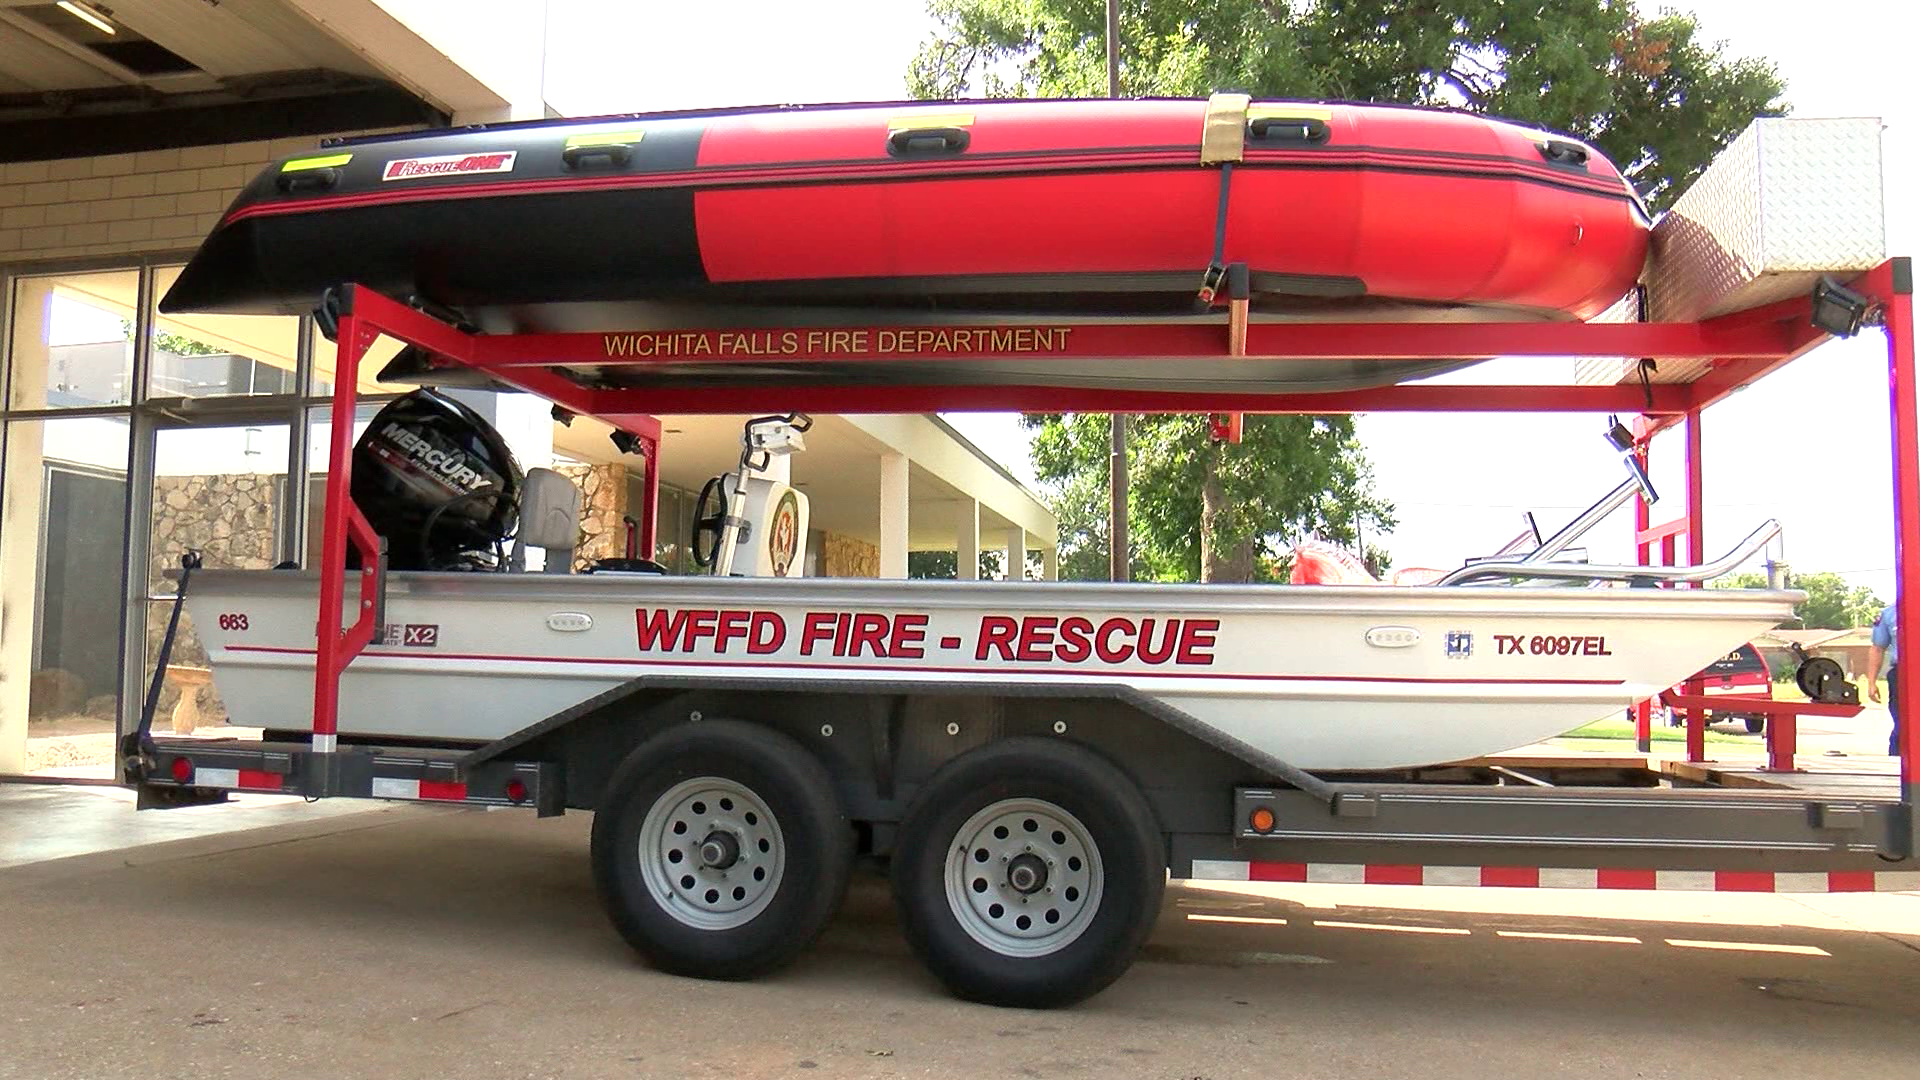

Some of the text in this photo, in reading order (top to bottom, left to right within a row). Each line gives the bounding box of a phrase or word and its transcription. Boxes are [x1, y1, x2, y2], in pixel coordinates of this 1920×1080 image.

[604, 328, 1072, 356] WICHITA FALLS FIRE DEPARTMENT
[381, 422, 492, 490] MERCURY
[219, 613, 249, 631] 663
[406, 627, 436, 643] X2
[635, 608, 787, 654] WFFD
[800, 612, 929, 659] FIRE
[975, 615, 1220, 665] RESCUE
[1493, 634, 1526, 655] TX
[1530, 635, 1612, 656] 6097EL
